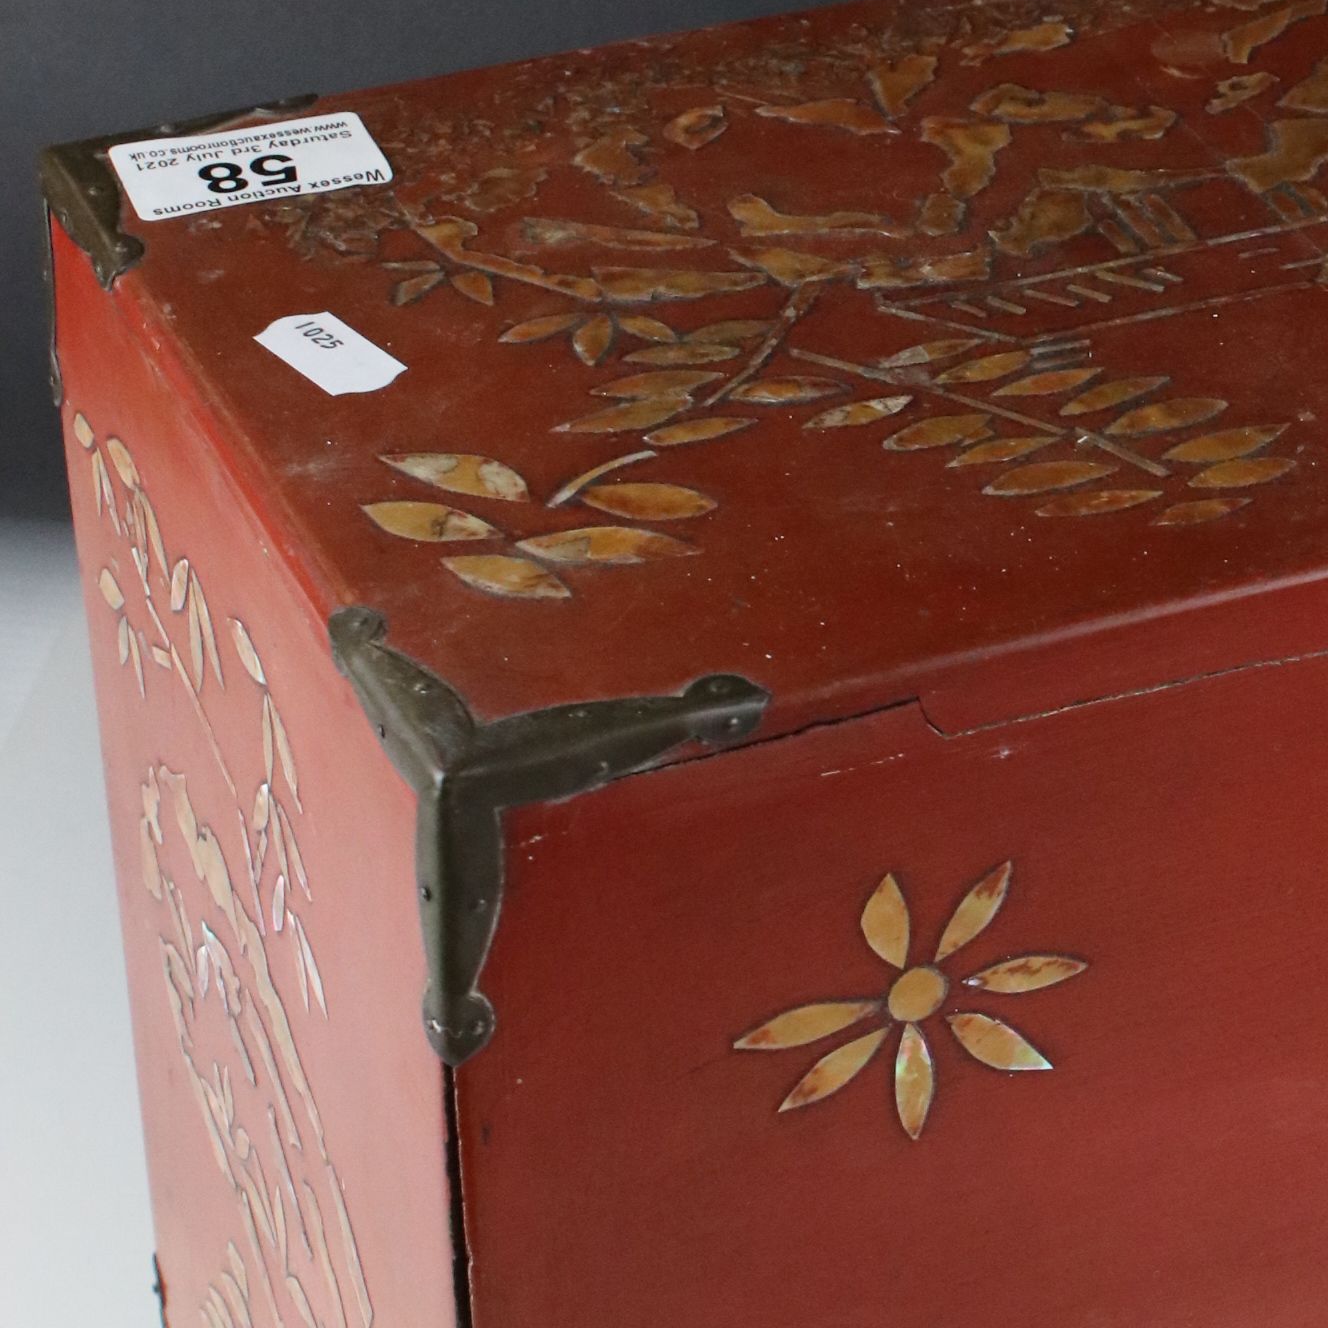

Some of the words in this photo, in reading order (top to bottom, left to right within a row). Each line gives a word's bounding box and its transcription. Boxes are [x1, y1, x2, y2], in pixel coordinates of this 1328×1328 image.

[128, 121, 349, 162] www.wessexauctionrooms.co.uk
[231, 142, 263, 156] 3rd
[268, 130, 353, 149] Saturday
[135, 158, 179, 172] 2021
[185, 150, 224, 164] July
[197, 154, 298, 194] 58
[308, 168, 386, 189] Wessex
[227, 183, 302, 203] Auction
[152, 197, 222, 216] Rooms
[294, 321, 344, 349] 1025
